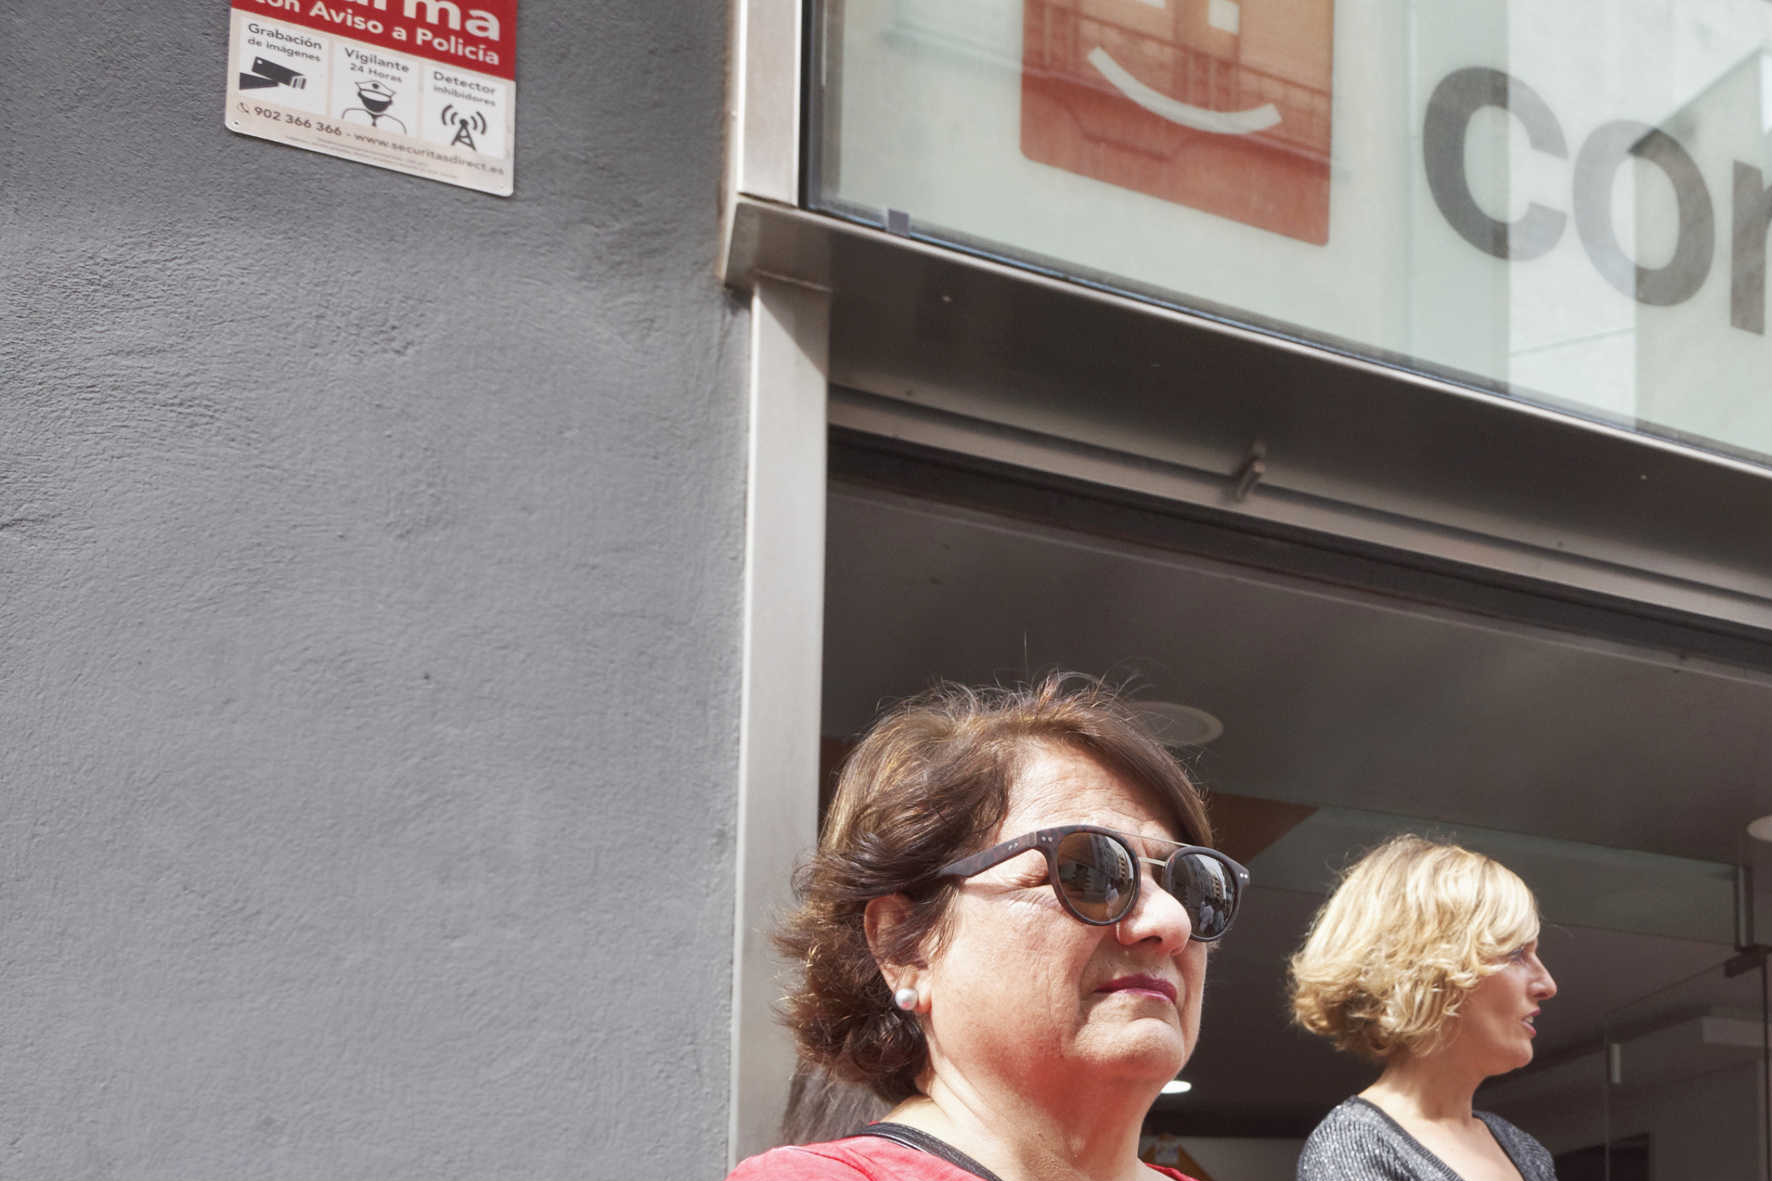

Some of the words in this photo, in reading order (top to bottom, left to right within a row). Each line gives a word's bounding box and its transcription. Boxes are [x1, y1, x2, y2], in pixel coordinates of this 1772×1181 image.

[248, 23, 322, 50] Grabación
[248, 38, 262, 47] de
[309, 1, 384, 34] Aviso
[391, 26, 407, 41] a
[416, 27, 499, 65] Policía
[345, 47, 409, 73] Vigilante
[350, 62, 364, 73] 24
[368, 66, 402, 83] Horas
[433, 71, 496, 95] Detector
[254, 106, 281, 121] 902
[285, 113, 312, 129] 366
[316, 121, 342, 137] 366
